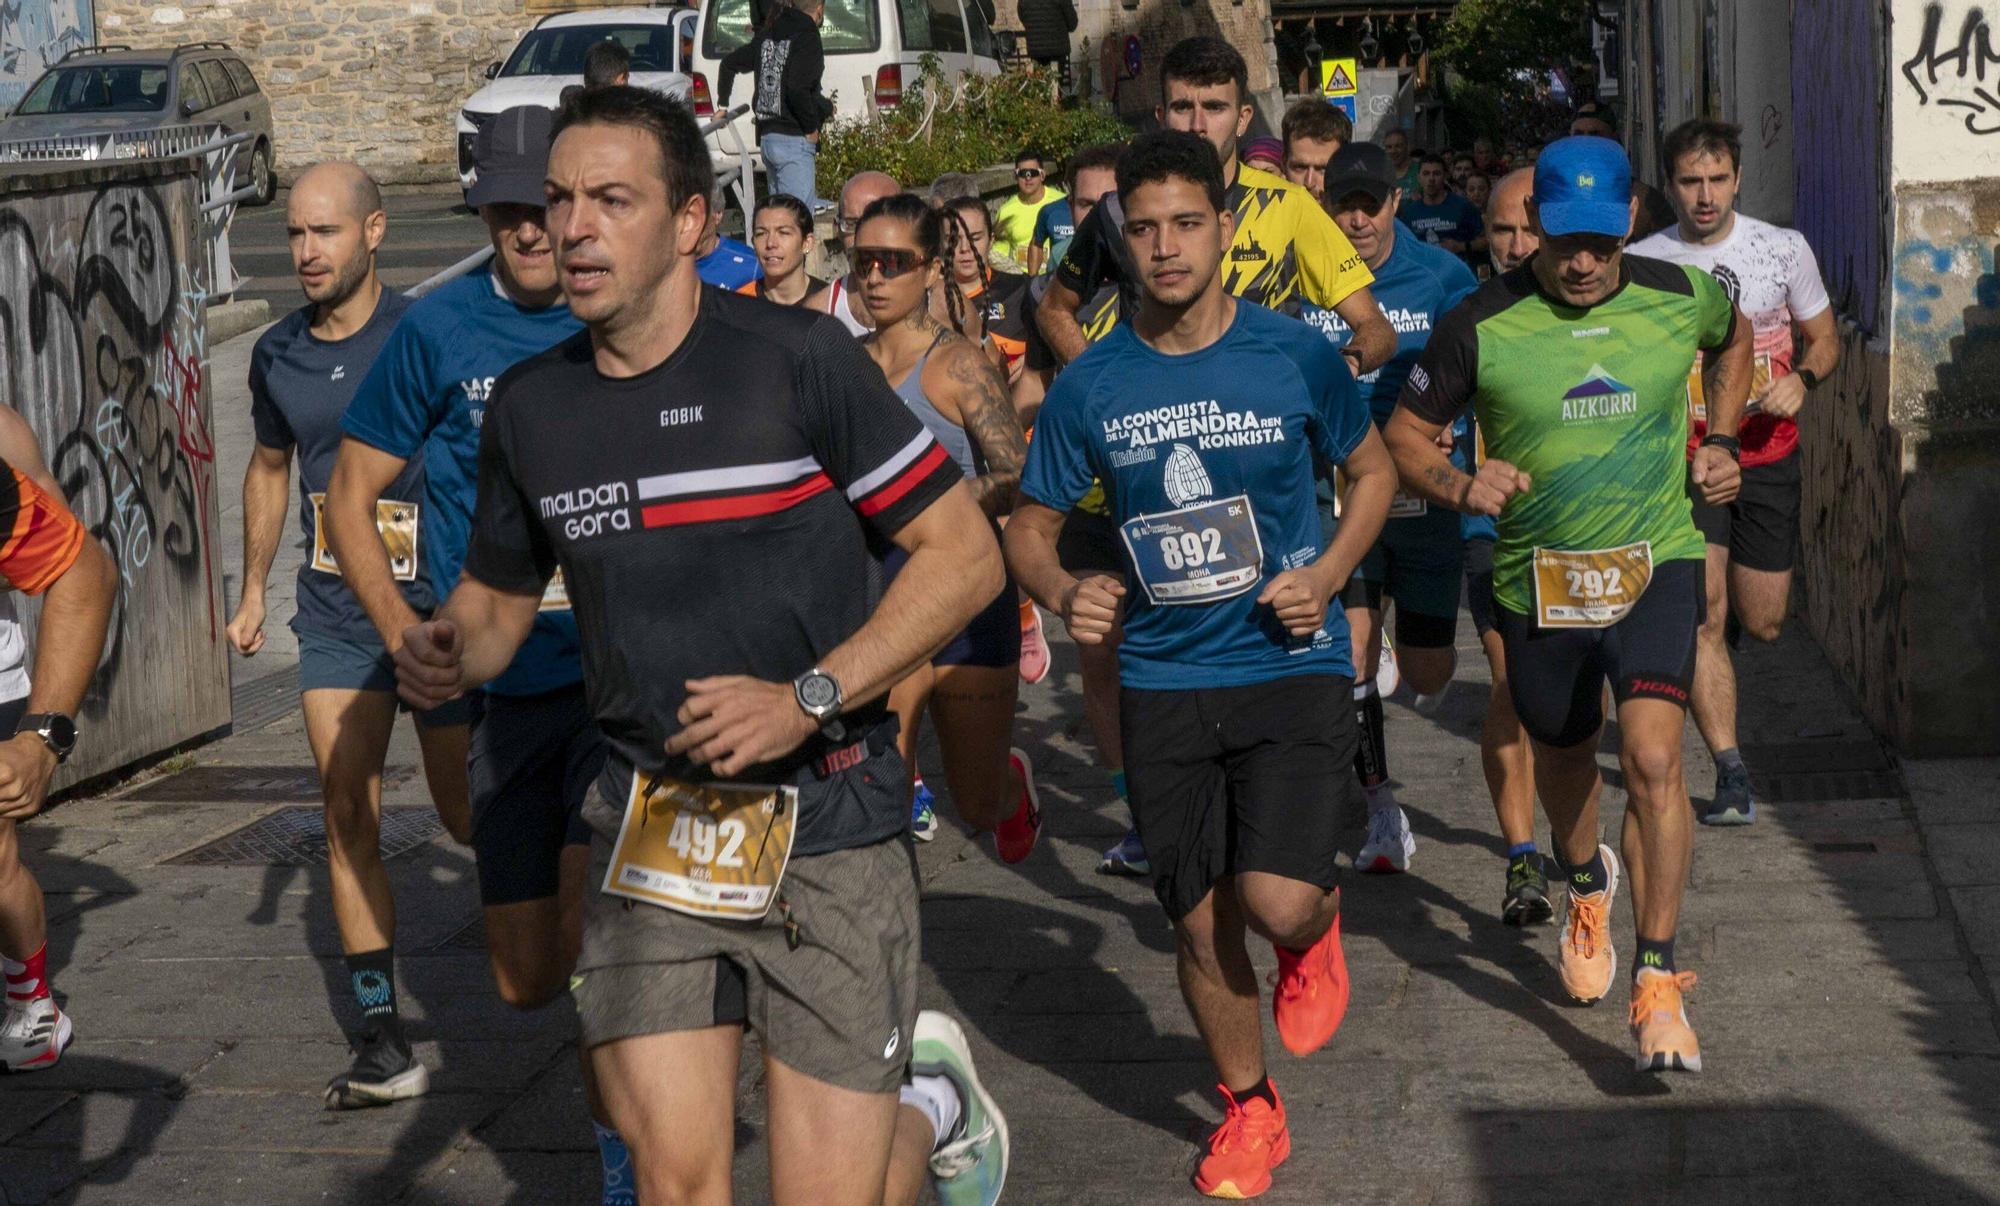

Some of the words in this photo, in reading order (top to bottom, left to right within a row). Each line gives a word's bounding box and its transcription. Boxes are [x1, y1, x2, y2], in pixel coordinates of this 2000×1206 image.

[660, 405, 703, 427] GOBIK
[1103, 418, 1122, 434] LA
[1122, 399, 1221, 428] CONQUISTA
[1562, 392, 1637, 421] AIZKORRI
[1105, 433, 1118, 443] DE
[1118, 430, 1130, 440] LA
[1130, 410, 1260, 448] ALMENDRA
[1260, 416, 1282, 428] REN
[1198, 427, 1285, 450] KONKISTA
[1227, 505, 1243, 517] 5K
[1160, 527, 1227, 571] 892
[1627, 549, 1643, 560] 10K
[1187, 568, 1211, 580] MOHA
[1566, 567, 1623, 599] 292
[668, 809, 747, 869] 492
